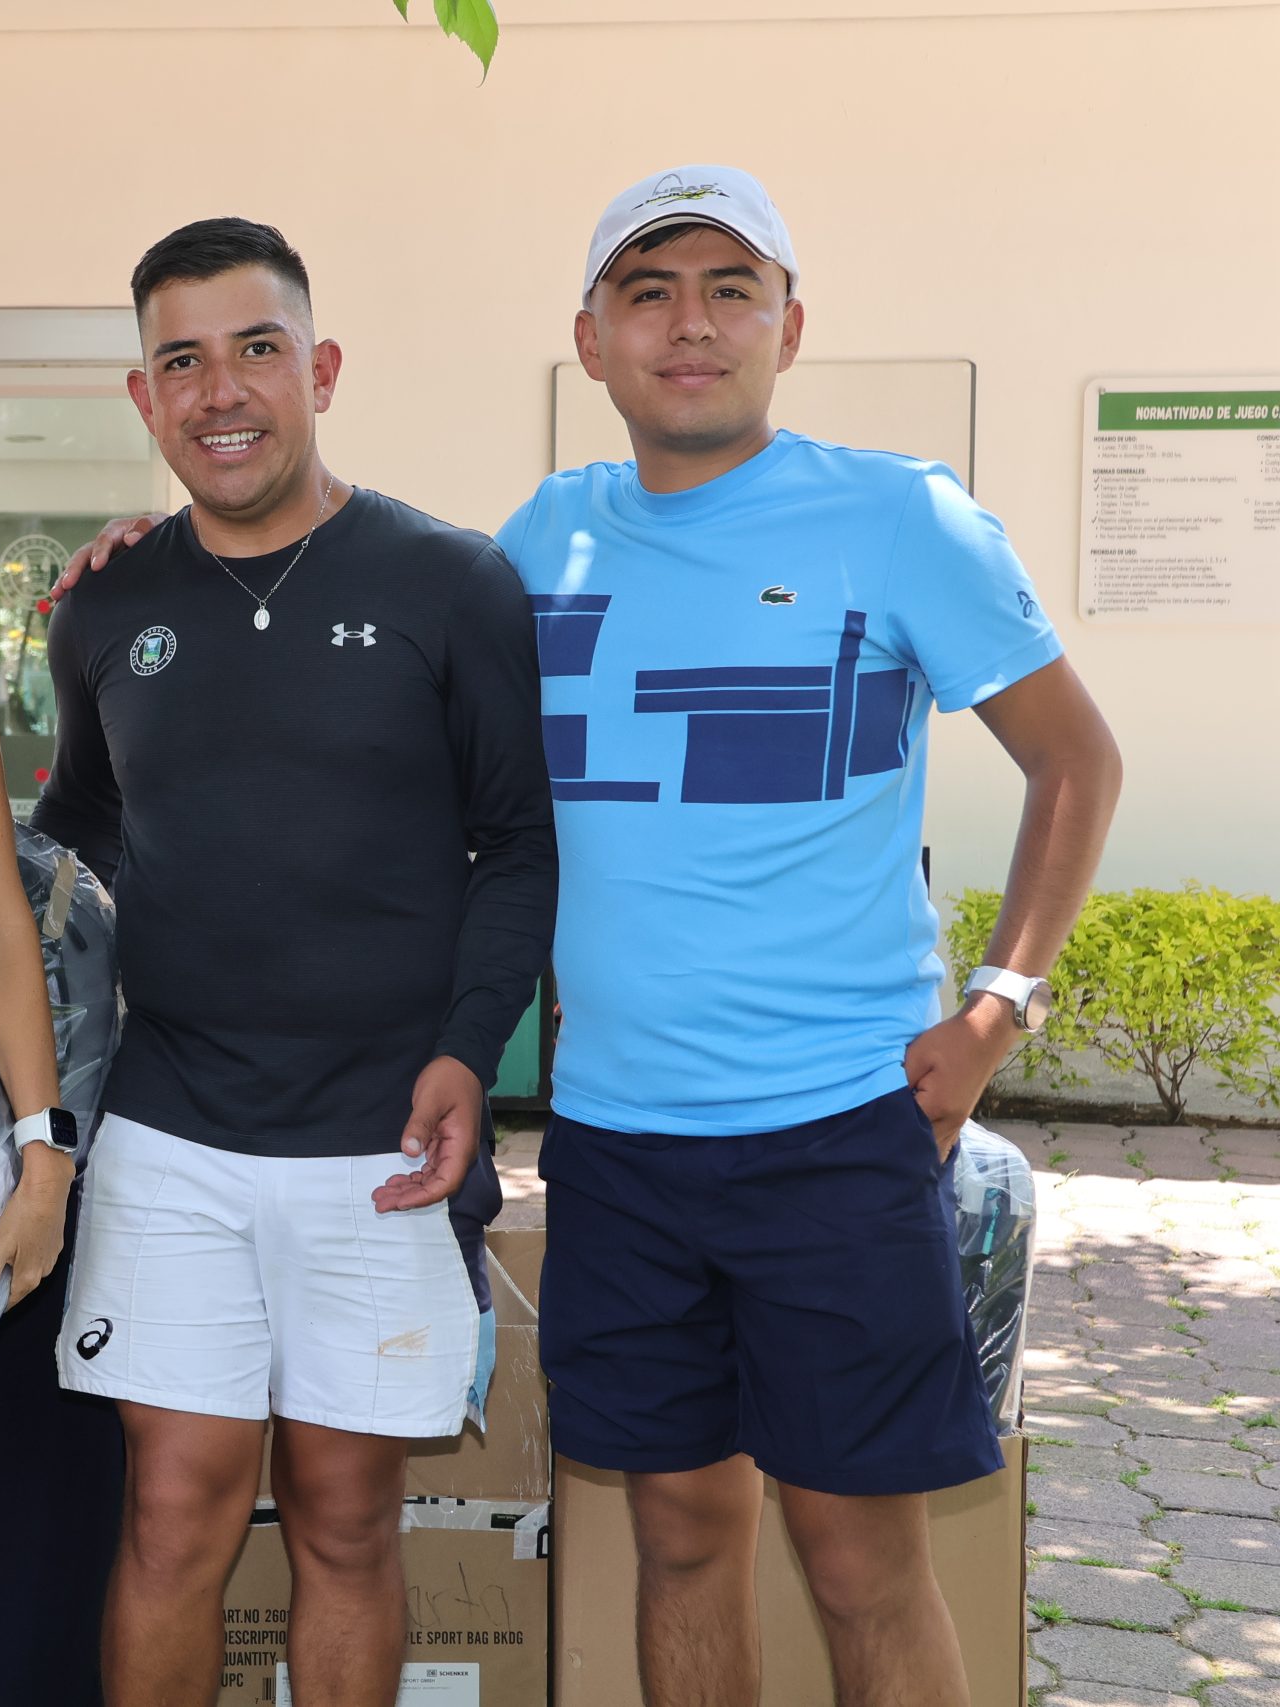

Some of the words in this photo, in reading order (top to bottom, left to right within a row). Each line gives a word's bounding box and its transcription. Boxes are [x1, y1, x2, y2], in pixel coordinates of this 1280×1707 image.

[1136, 406, 1214, 420] NORMATIVIDAD
[1216, 406, 1231, 420] DE
[1234, 406, 1268, 418] JUEGO
[1272, 406, 1280, 418] C
[265, 1609, 289, 1623] 260
[224, 1630, 287, 1644] ESCRIPTIO
[408, 1631, 422, 1644] LE
[427, 1631, 463, 1645] SPORT
[467, 1631, 489, 1645] BAG
[494, 1631, 523, 1645] BKDG
[221, 1673, 243, 1687] UPC
